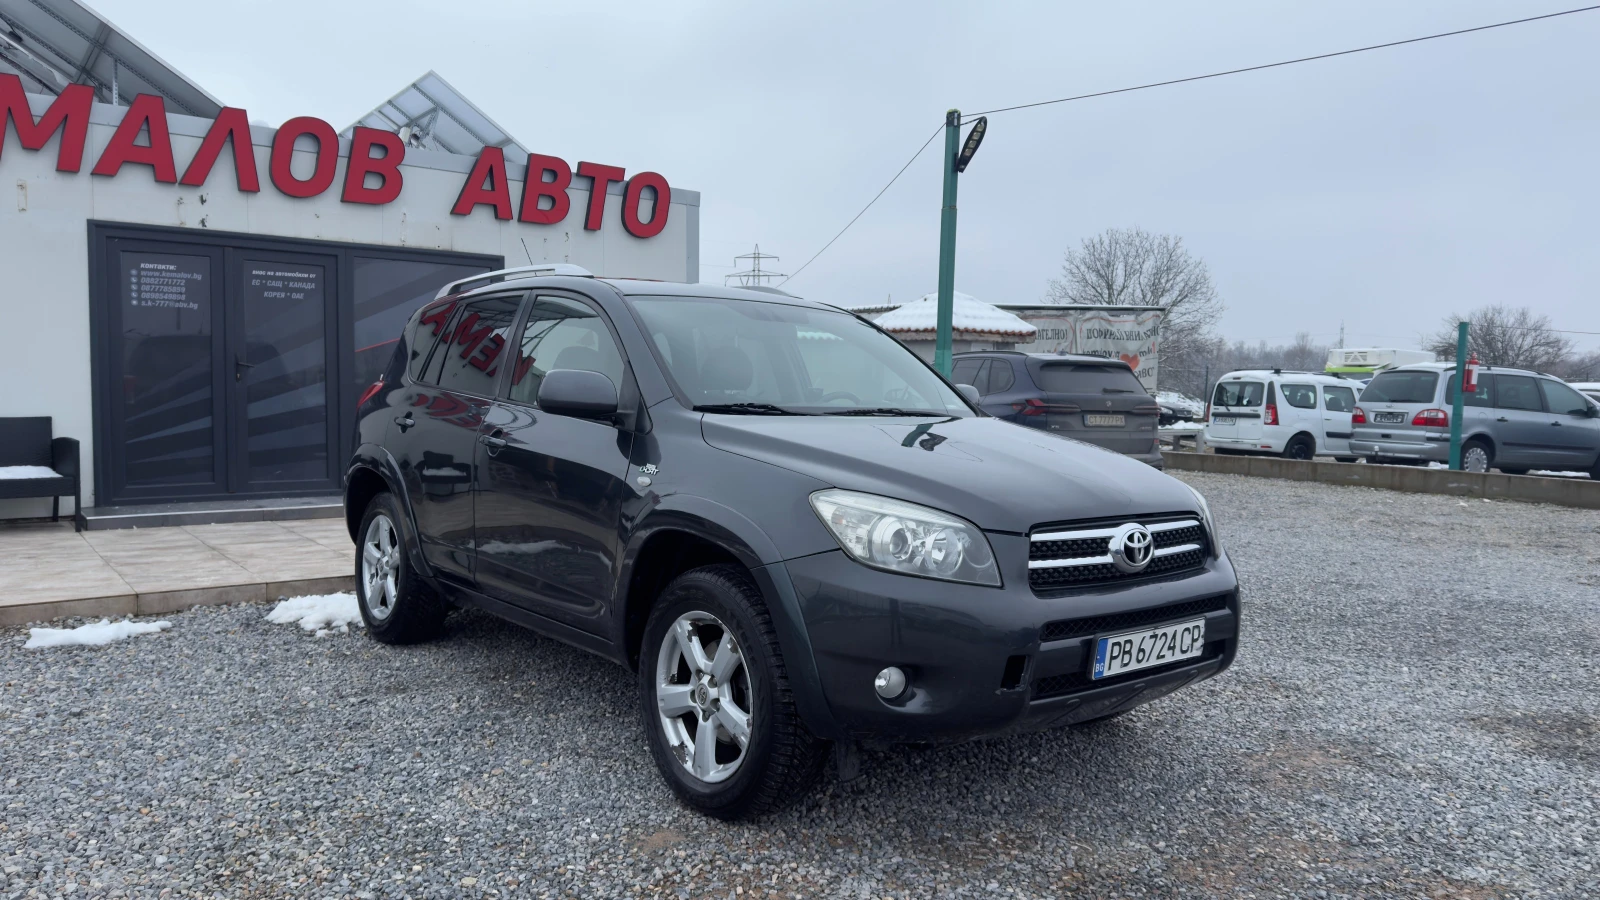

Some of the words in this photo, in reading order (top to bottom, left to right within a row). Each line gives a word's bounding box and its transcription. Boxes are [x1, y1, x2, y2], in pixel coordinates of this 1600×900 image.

[0, 72, 406, 205] МАЛОВ
[450, 145, 671, 238] АВТО
[141, 270, 202, 281] www.kemalov.bg
[267, 280, 282, 288] САЩ
[289, 281, 315, 290] КАНАДА
[292, 292, 304, 300] ОАЕ
[1036, 328, 1068, 341] АТЕЛНО!
[1108, 639, 1133, 671] PB
[1136, 629, 1177, 664] 6724
[1180, 625, 1201, 655] CP
[1095, 663, 1104, 672] BG
